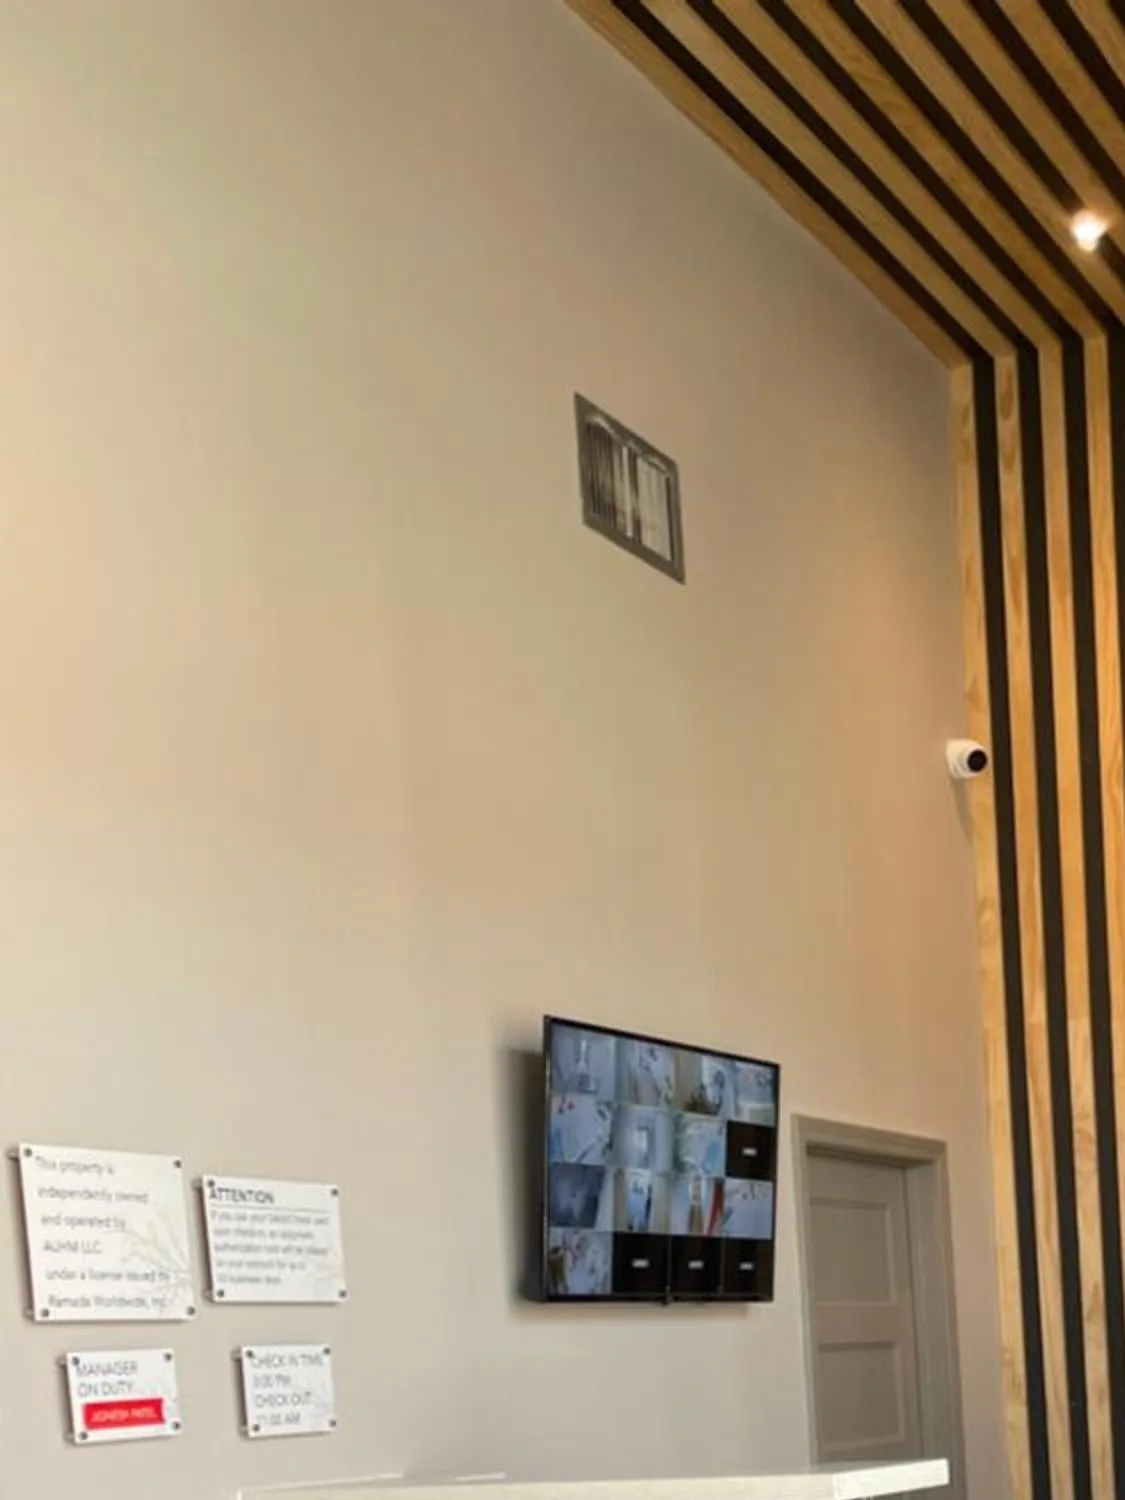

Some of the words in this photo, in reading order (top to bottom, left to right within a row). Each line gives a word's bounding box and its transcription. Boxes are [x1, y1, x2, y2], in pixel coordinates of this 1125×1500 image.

[59, 1160, 103, 1177] property
[107, 1164, 115, 1175] is
[38, 1186, 112, 1202] independently
[115, 1190, 149, 1203] owned
[209, 1186, 275, 1204] ATTENTION
[41, 1213, 61, 1225] and
[64, 1215, 111, 1230] operated
[113, 1216, 127, 1231] by
[81, 1239, 103, 1254] LLC
[45, 1268, 77, 1281] under
[76, 1359, 138, 1377] MANAGER
[251, 1353, 286, 1369] CHECK
[78, 1381, 98, 1398] ON
[102, 1380, 135, 1396] DUTY
[254, 1393, 289, 1409] CHECK
